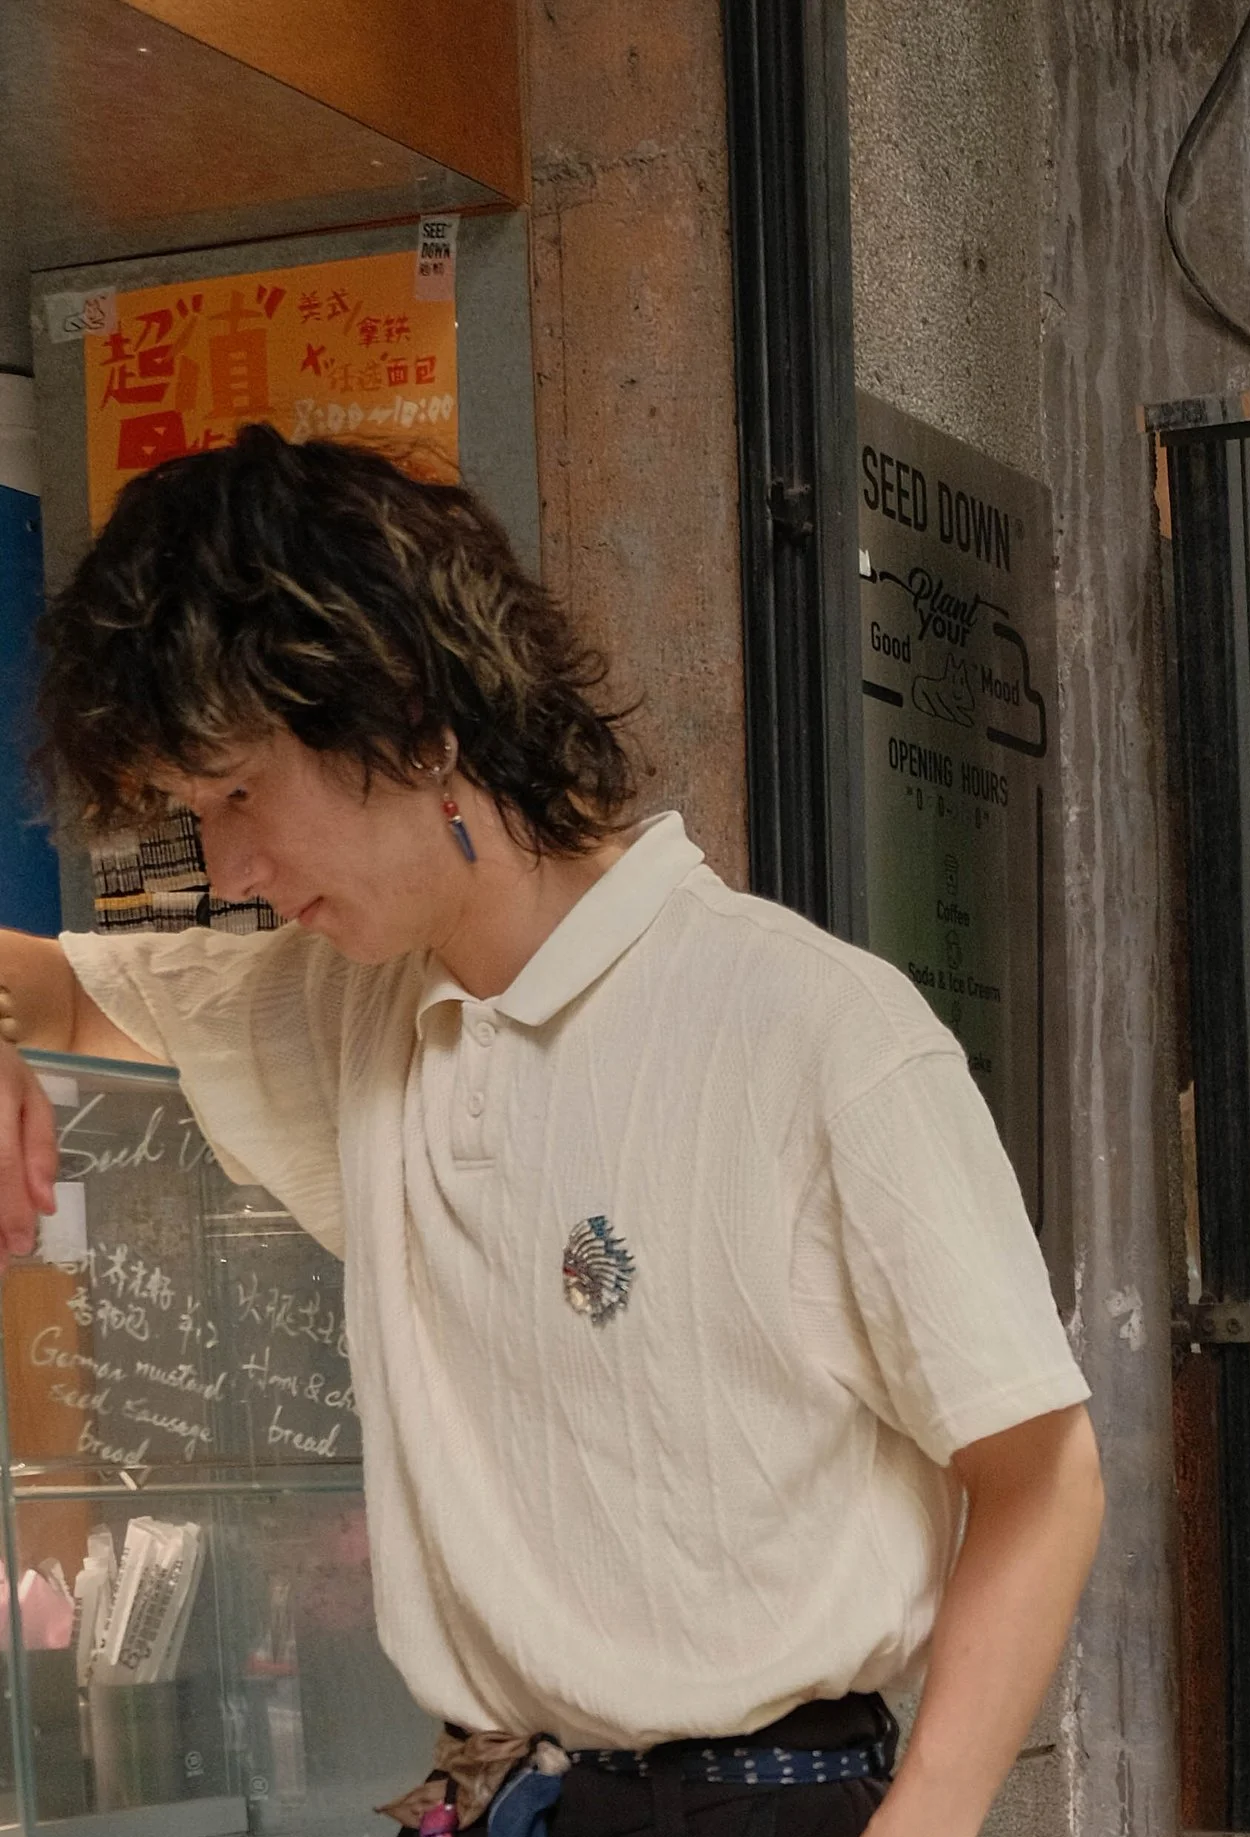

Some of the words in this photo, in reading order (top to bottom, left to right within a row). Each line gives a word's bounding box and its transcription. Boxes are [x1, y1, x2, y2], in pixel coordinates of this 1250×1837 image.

[863, 445, 928, 532] SEED
[938, 480, 1011, 572] DOWN
[908, 567, 980, 628] Plant
[871, 621, 912, 664] Good
[980, 665, 1021, 707] Mood
[888, 737, 953, 788] OPENING
[961, 761, 1009, 807] HOURS
[937, 900, 970, 927] Coffee
[908, 962, 935, 989] Soda
[950, 973, 965, 994] Ice
[967, 976, 1000, 1002] Cream
[969, 1055, 992, 1074] ake
[304, 1373, 326, 1404] &
[267, 1405, 341, 1458] bread
